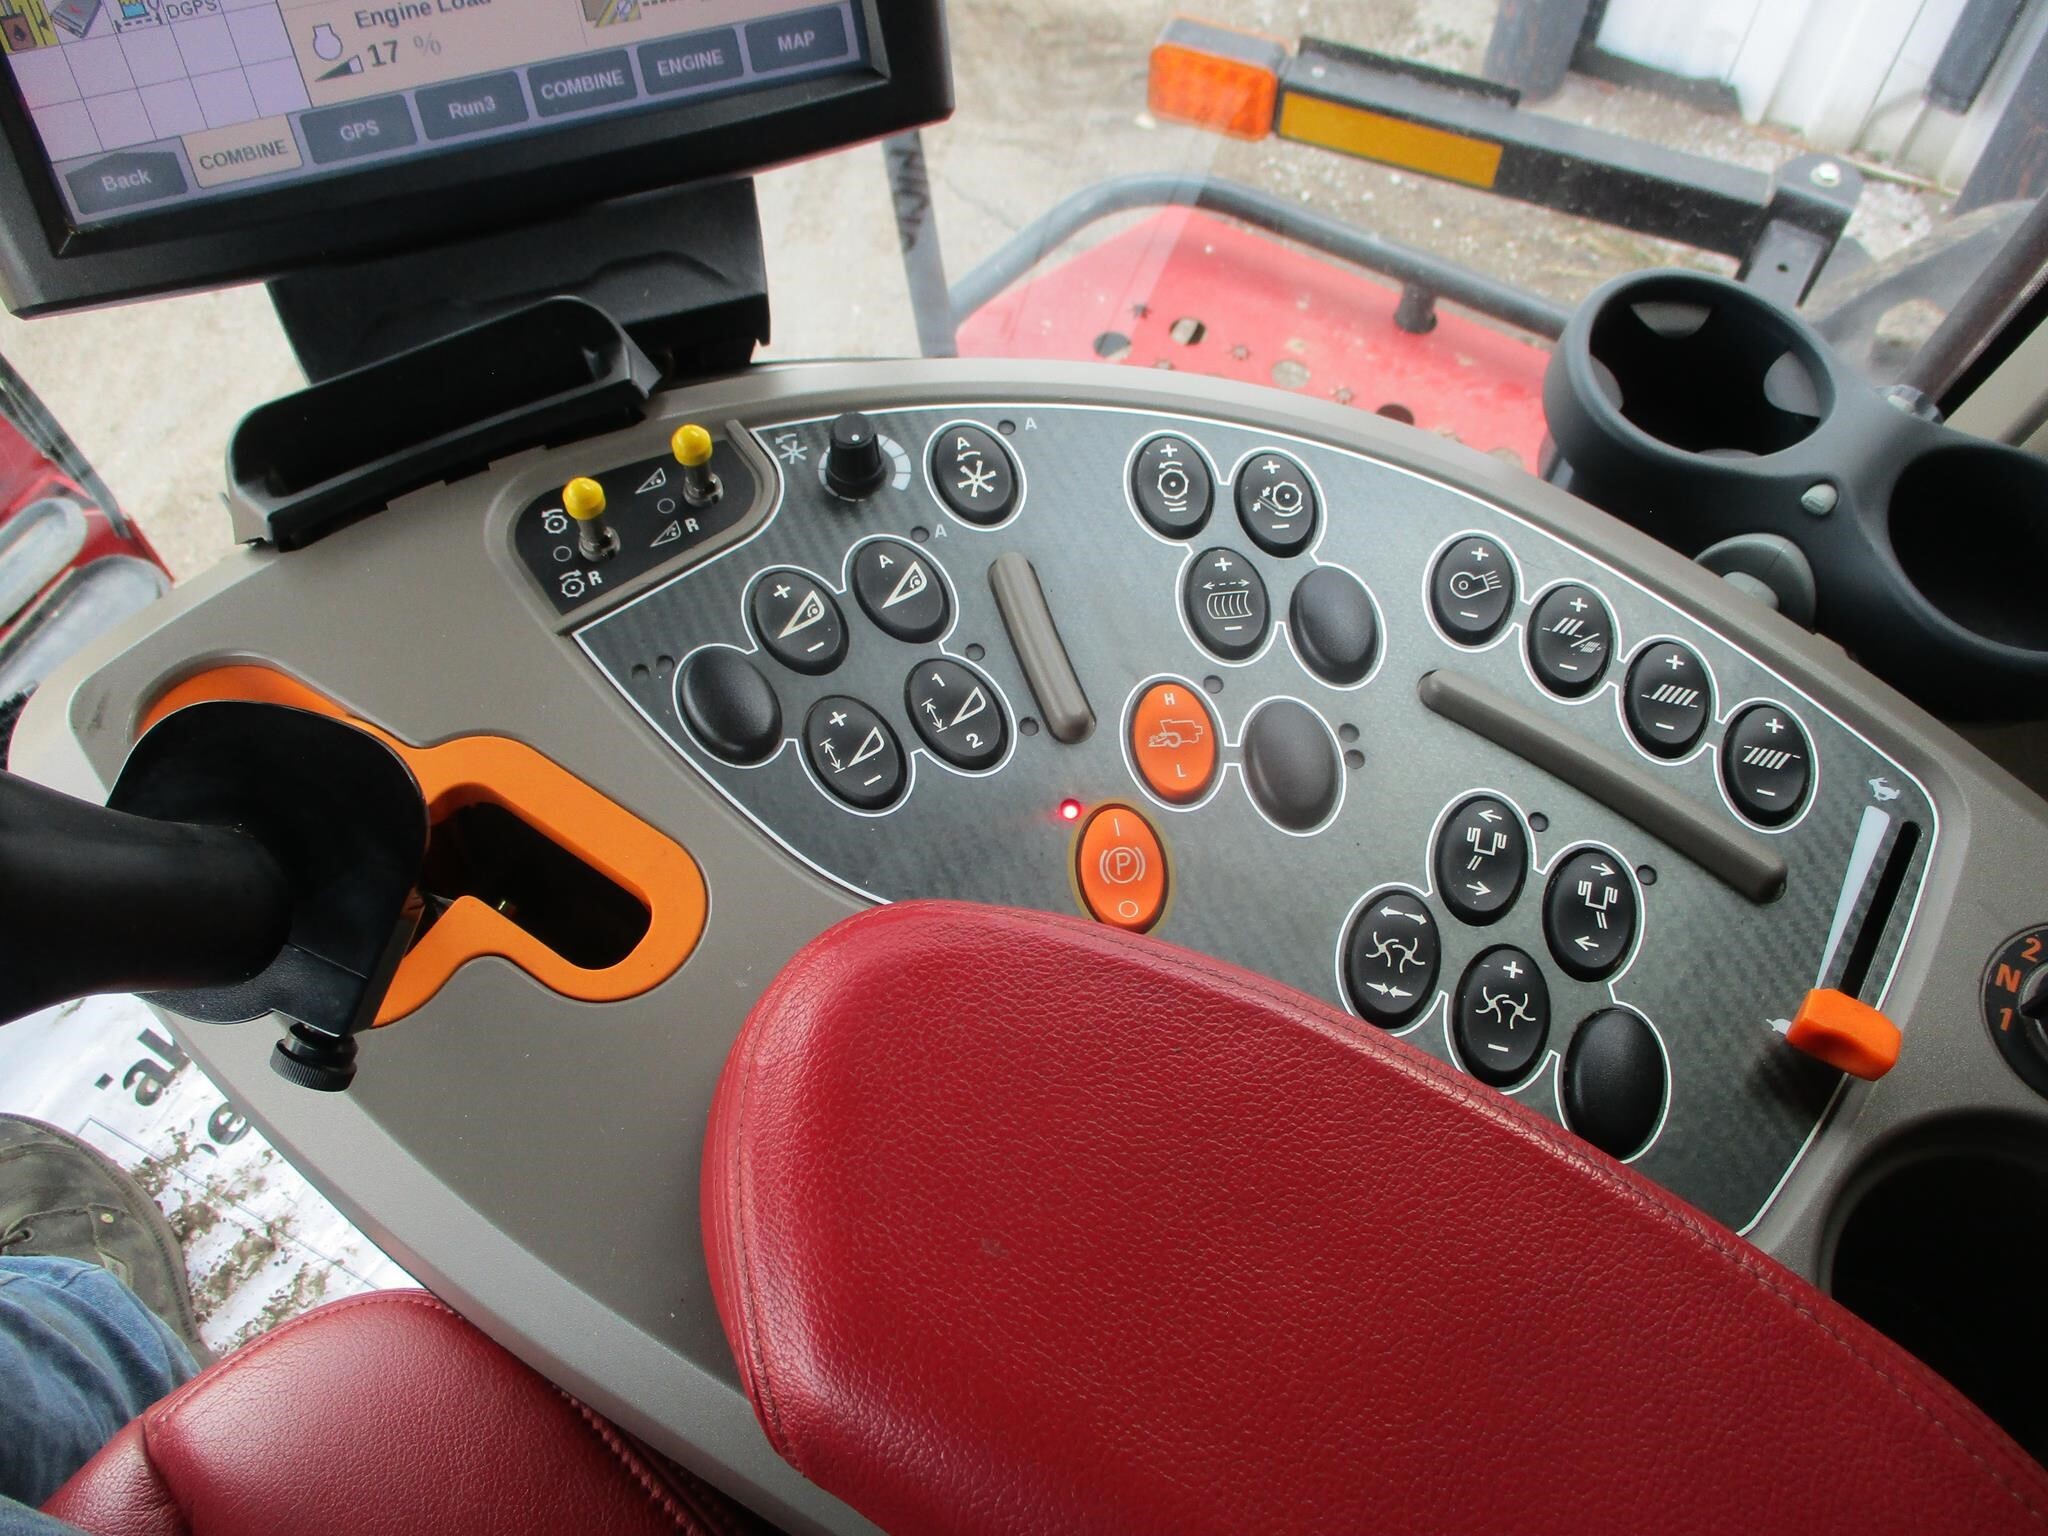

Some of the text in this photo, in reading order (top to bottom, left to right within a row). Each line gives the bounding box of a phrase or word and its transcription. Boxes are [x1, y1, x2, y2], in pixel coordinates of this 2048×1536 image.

[166, 0, 217, 19] DGPS
[355, 1, 432, 29] Engine
[367, 33, 442, 67] 17 %
[778, 31, 816, 53] MAP
[656, 49, 725, 77] ENGINE
[541, 70, 625, 100] COMBINE
[448, 96, 497, 120] Run3
[340, 120, 381, 143] GPS
[200, 139, 289, 170] COMBINE
[101, 168, 152, 193] Back
[1024, 416, 1038, 431] A
[956, 436, 971, 450] A
[684, 517, 701, 533] R
[934, 523, 948, 539] A
[878, 553, 895, 569] A
[587, 570, 603, 586] R
[931, 672, 946, 687] 1
[1164, 692, 1176, 705] H
[965, 732, 984, 749] 2
[1176, 764, 1187, 778] L
[2020, 936, 2043, 963] 2
[1994, 963, 2022, 993] N
[2000, 1007, 2013, 1032] 1
